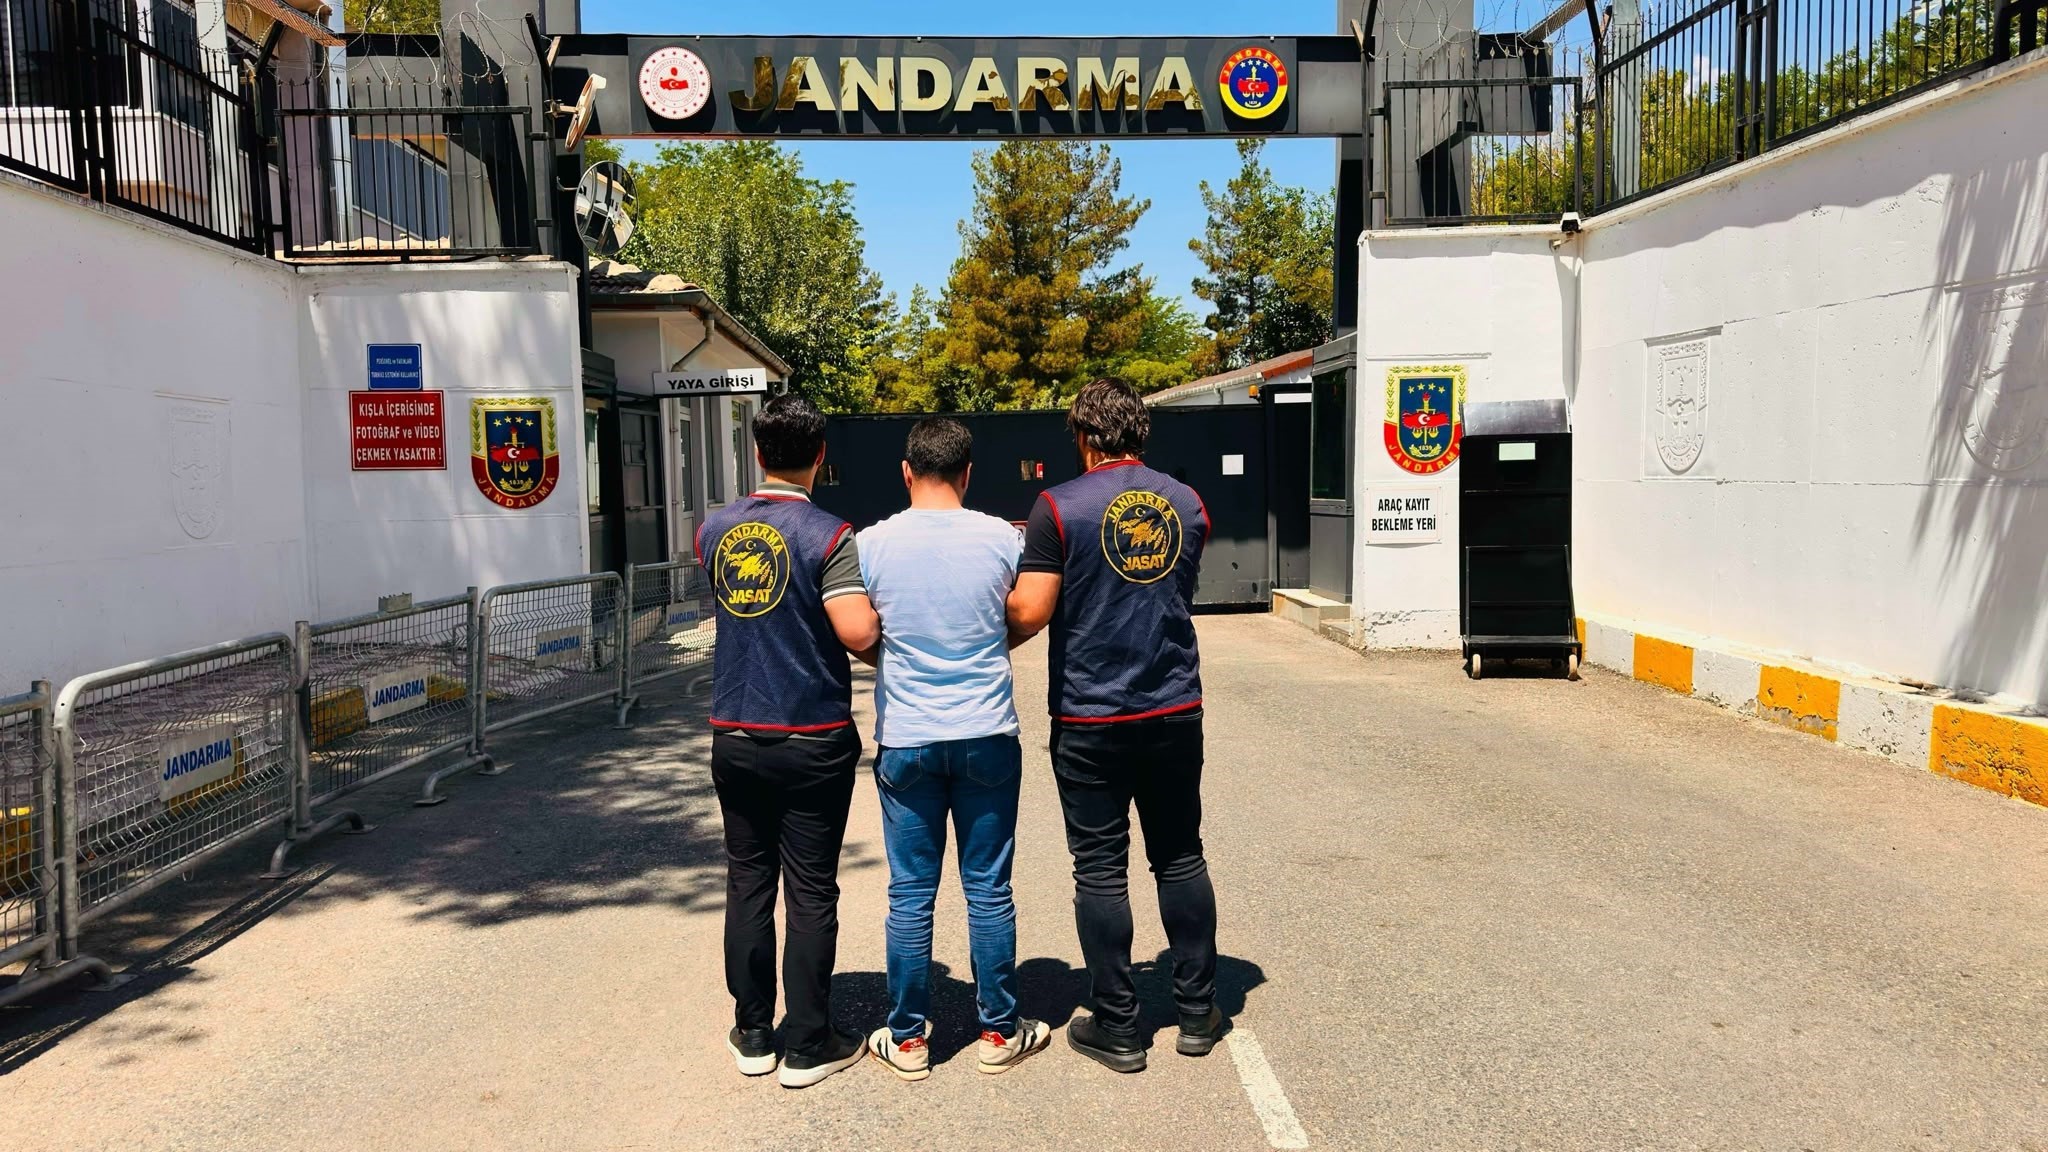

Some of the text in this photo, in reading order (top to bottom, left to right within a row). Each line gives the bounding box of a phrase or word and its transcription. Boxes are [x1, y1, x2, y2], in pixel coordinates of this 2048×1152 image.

[1223, 49, 1285, 77] JANDARMA
[728, 55, 1204, 112] JANDARMA
[668, 374, 754, 390] YAYA GİRİŞİ
[359, 400, 435, 418] KIŞLA İÇERİSİNDE
[356, 422, 440, 439] FOTOĞRAF ve VİDEO
[356, 447, 391, 462] ÇEKMEK
[393, 447, 436, 460] YASAKTIR
[478, 476, 556, 507] JANDARMA
[1108, 493, 1173, 524] JANDARMA
[1378, 498, 1430, 514] ARAÇ KAYIT
[1372, 514, 1436, 531] BEKLEME YERİ
[720, 525, 784, 556] JANDARMA
[1122, 554, 1167, 571] JASAT
[728, 588, 772, 604] JASAT
[536, 634, 580, 656] JANDARMA
[372, 678, 425, 708] JANDARMA
[163, 738, 232, 781] JANDARMA
